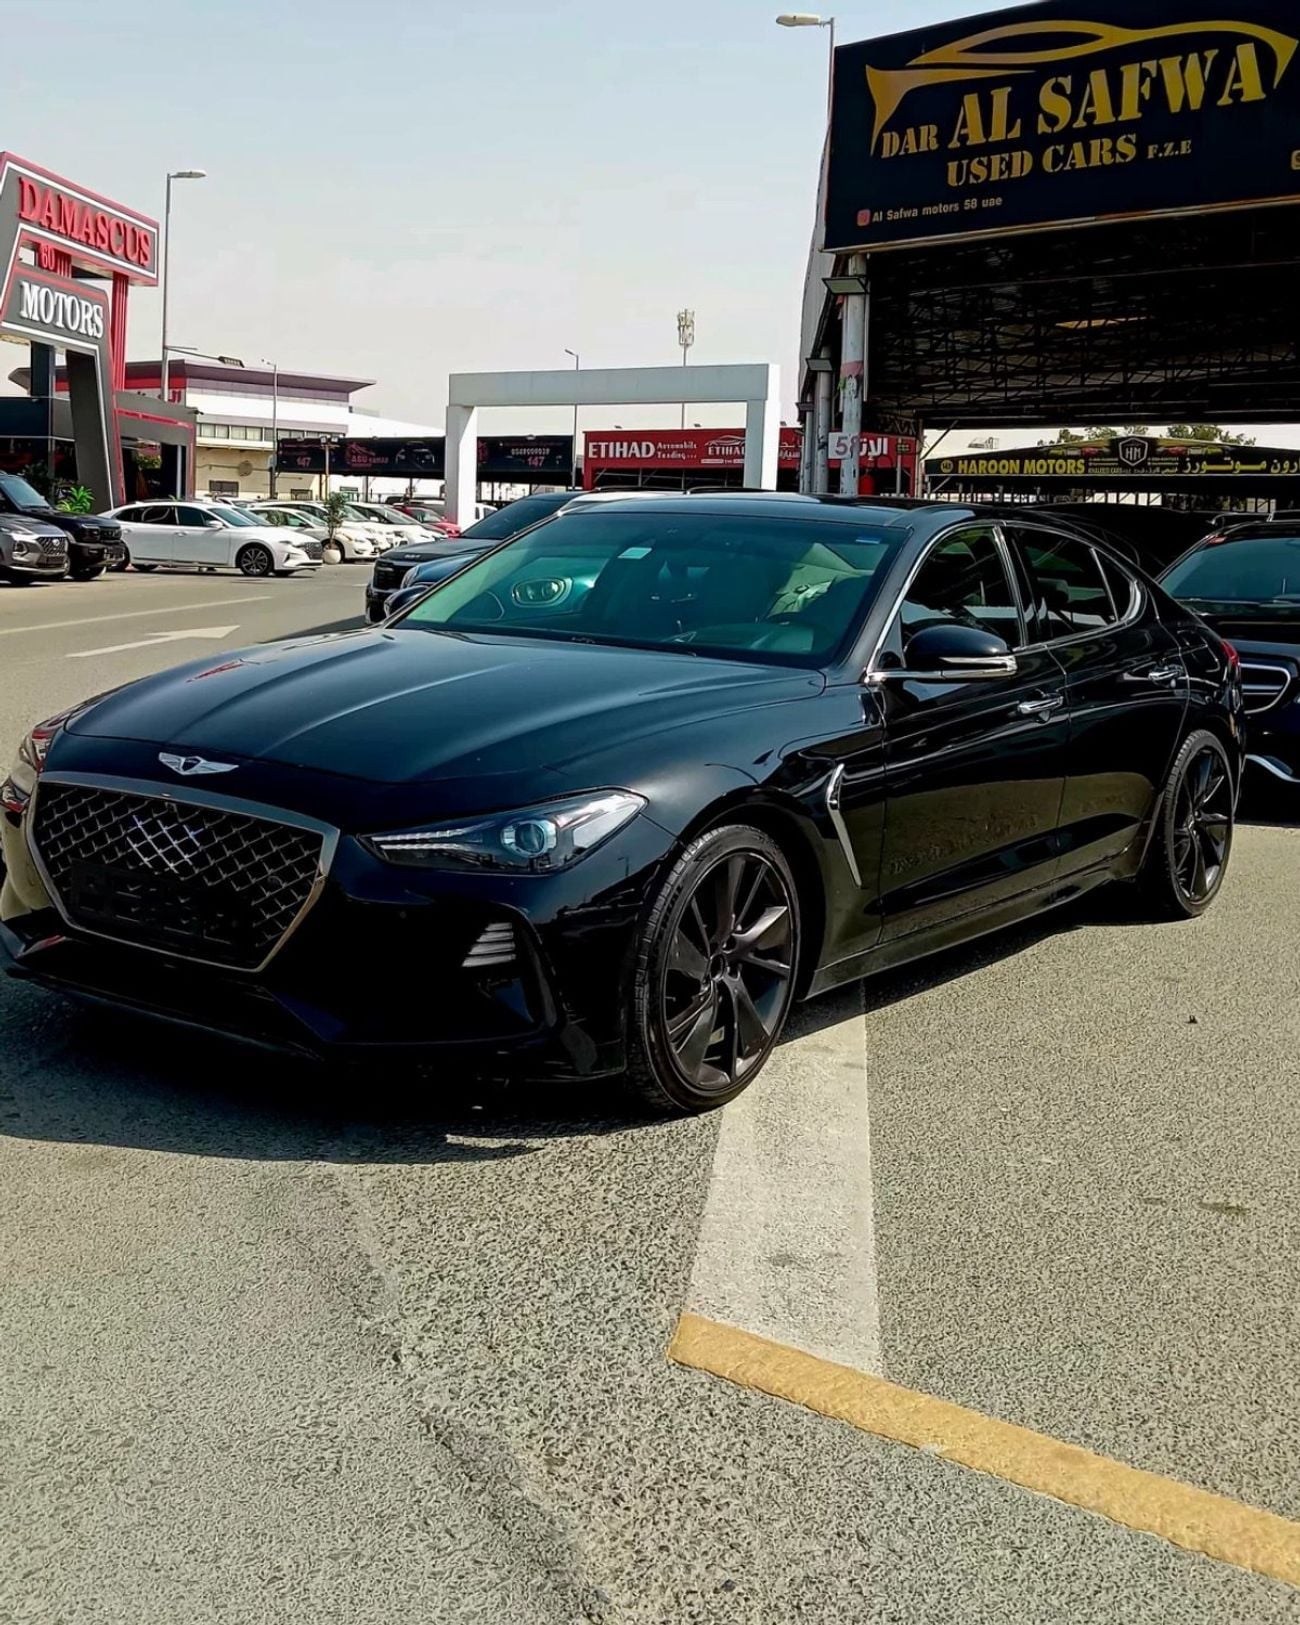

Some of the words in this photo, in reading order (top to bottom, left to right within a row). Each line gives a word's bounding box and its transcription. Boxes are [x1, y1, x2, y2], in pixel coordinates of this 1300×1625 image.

[881, 124, 939, 159] DAR
[948, 86, 1022, 149] AL
[1037, 42, 1267, 135] SAFWA
[947, 150, 1033, 187] USED
[1042, 133, 1137, 173] CARS
[18, 176, 151, 268] DAMASCUS
[872, 210, 883, 222] Al
[886, 206, 918, 221] Safwa
[922, 201, 960, 216] motors
[963, 198, 978, 210] 58
[981, 197, 1003, 208] uae
[41, 244, 56, 271] 60
[19, 281, 104, 339] MOTORS
[527, 456, 545, 467] 147
[588, 441, 656, 459] ETIHAD
[1125, 447, 1141, 461] HM
[957, 459, 1020, 474] HAROON
[1023, 459, 1086, 474] MOTORS
[1182, 456, 1267, 474] موتورز
